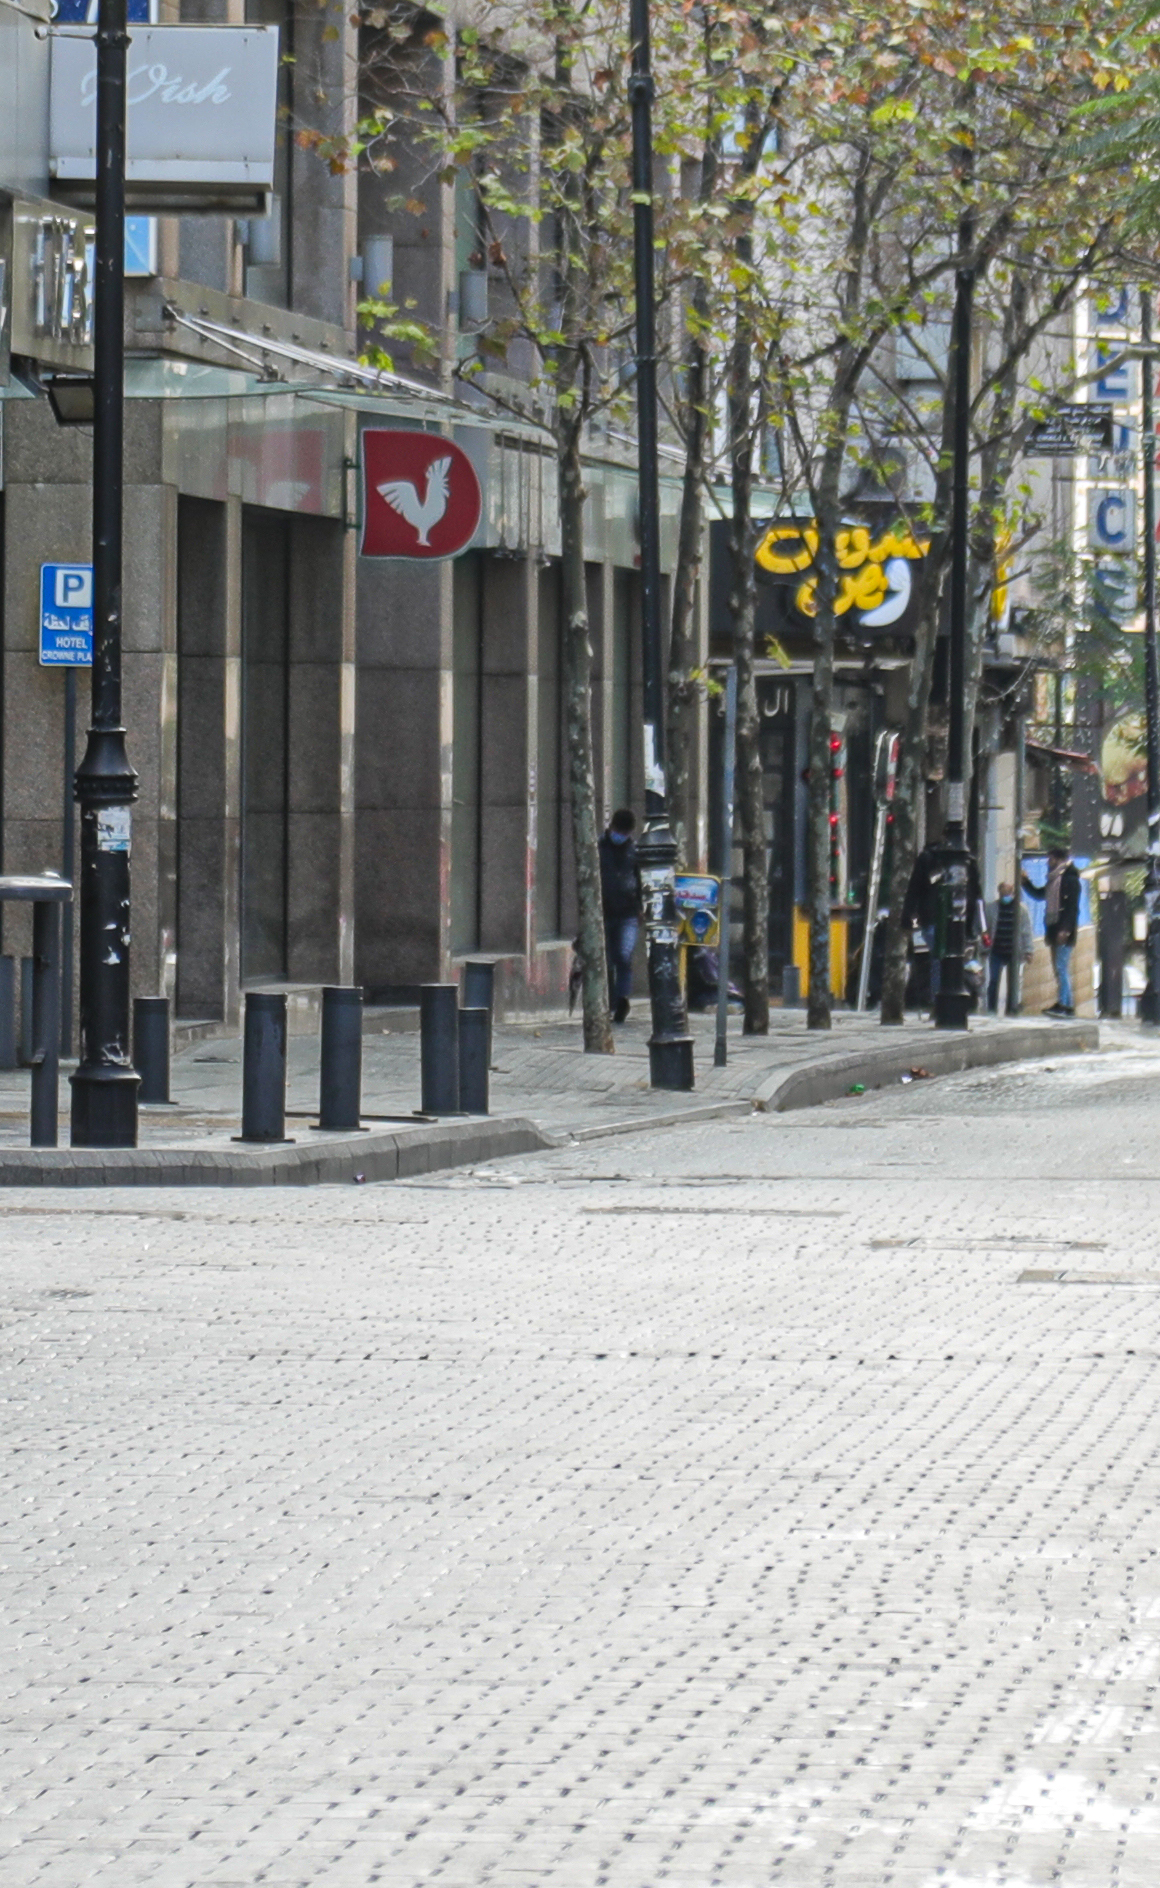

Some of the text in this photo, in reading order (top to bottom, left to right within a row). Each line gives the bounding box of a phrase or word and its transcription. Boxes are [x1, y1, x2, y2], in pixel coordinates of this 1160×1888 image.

[62, 573, 85, 604] P
[55, 637, 88, 650] HOTEL
[41, 650, 93, 662] CROWNE PLA
